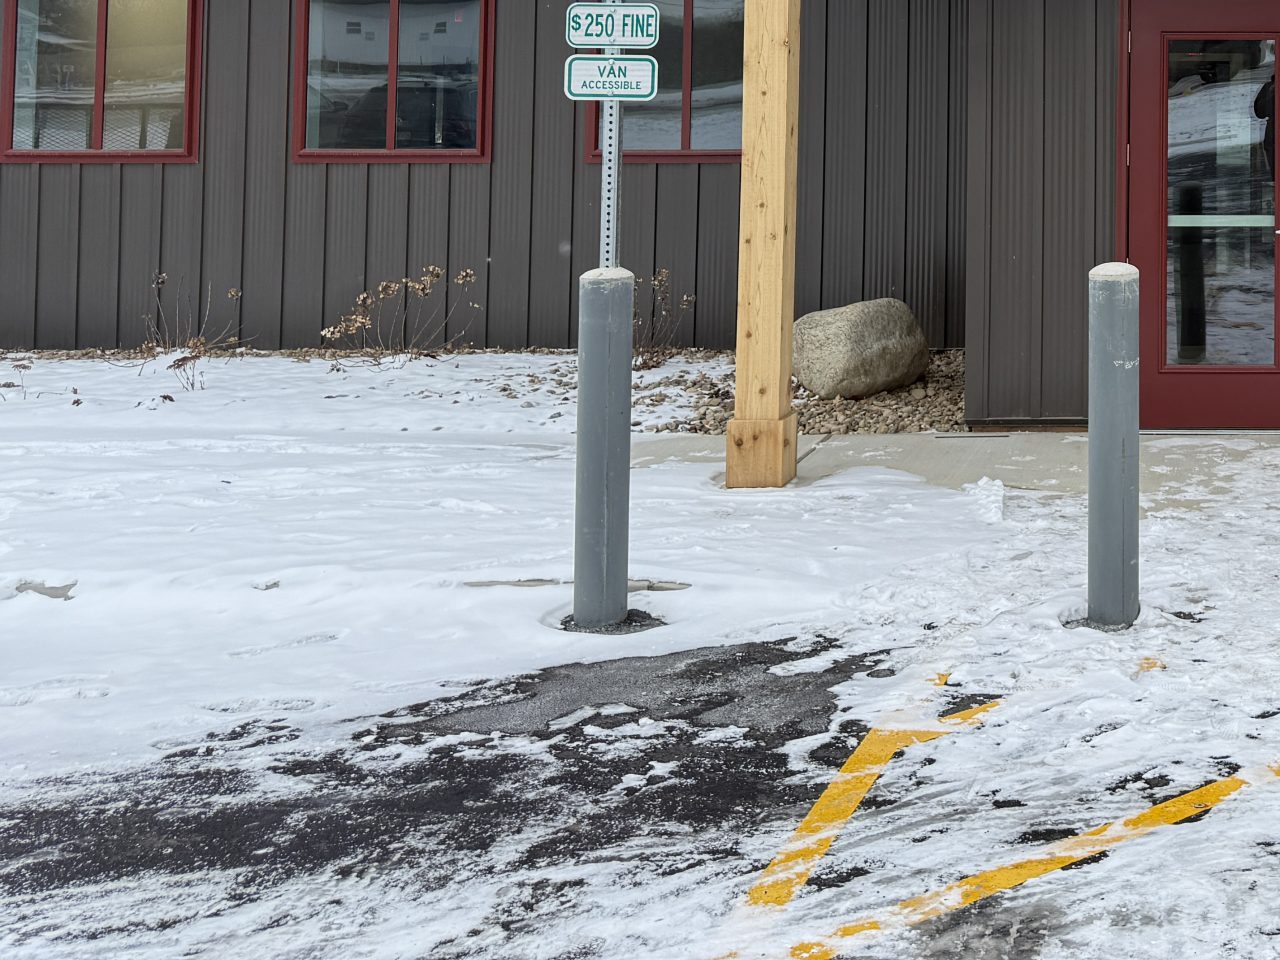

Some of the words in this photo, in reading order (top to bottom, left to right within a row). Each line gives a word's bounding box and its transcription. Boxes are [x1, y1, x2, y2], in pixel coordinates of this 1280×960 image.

[622, 14, 654, 38] FINE
[598, 65, 627, 78] VAN
[581, 80, 642, 90] ACCESSIBLE
